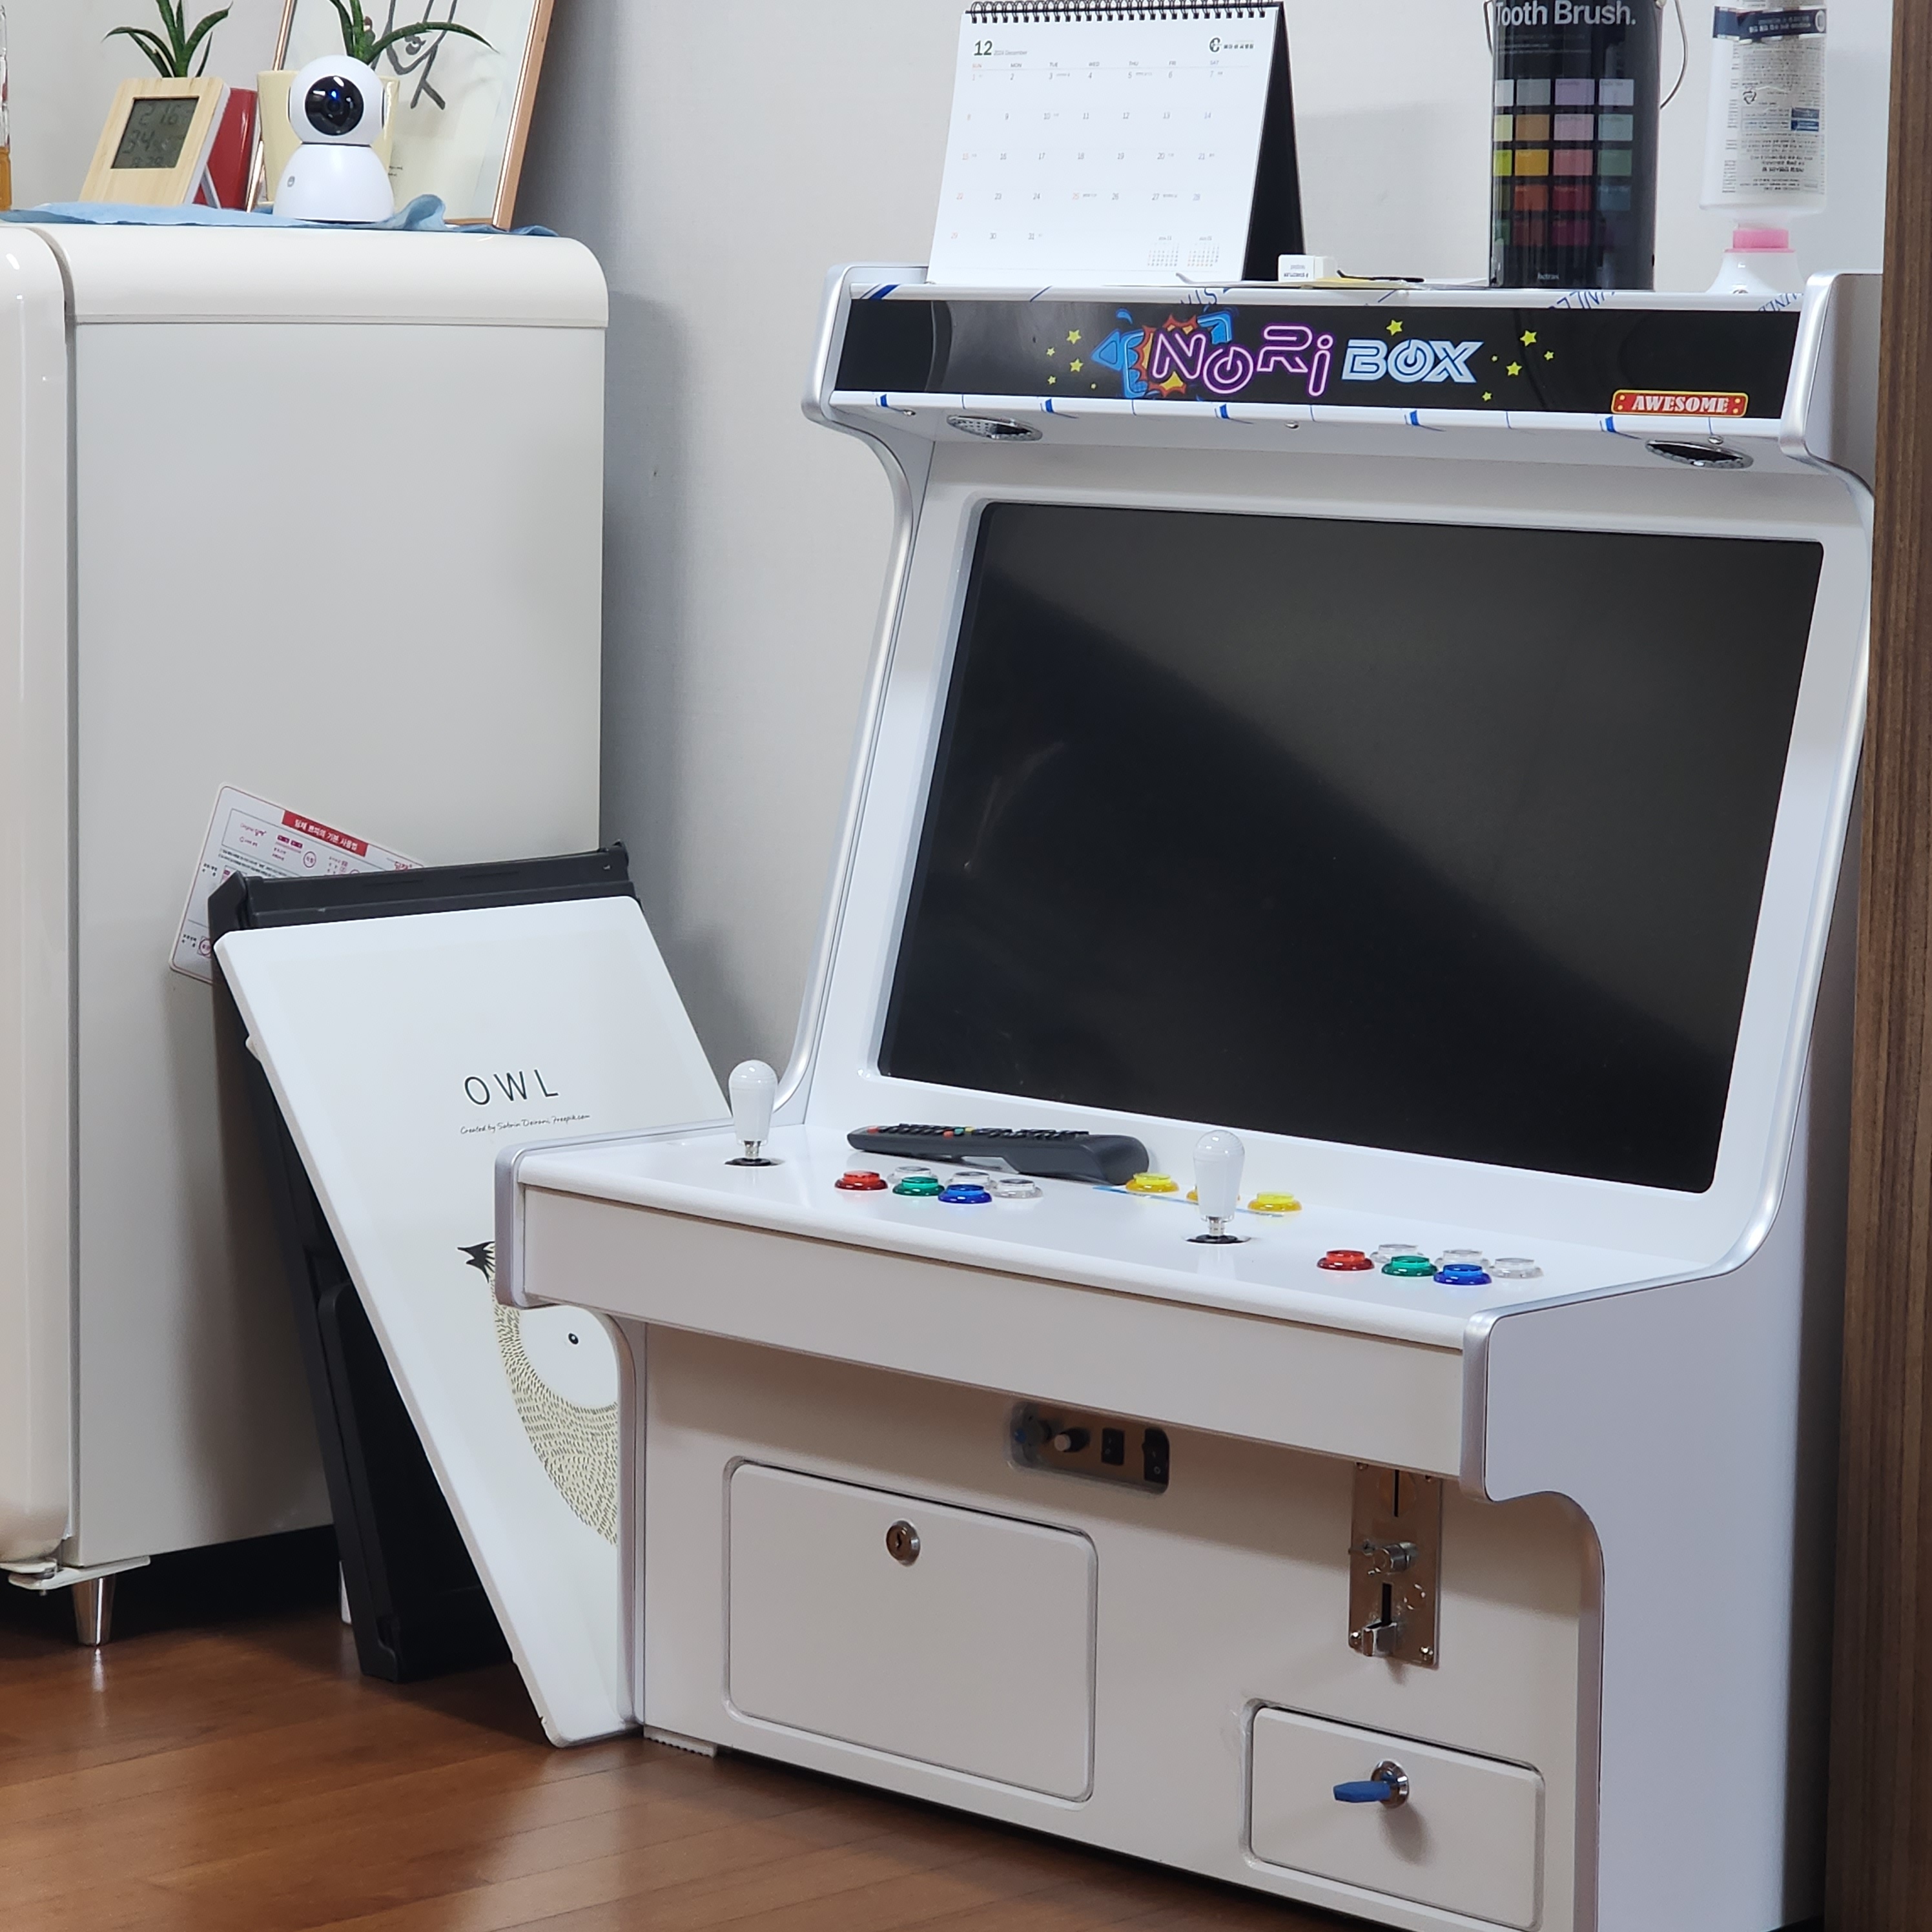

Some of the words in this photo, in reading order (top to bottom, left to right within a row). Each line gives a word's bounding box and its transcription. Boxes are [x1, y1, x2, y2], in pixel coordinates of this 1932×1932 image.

[1495, 0, 1548, 25] Tooth
[1554, 0, 1636, 25] Brush.
[973, 39, 993, 56] 12
[1000, 152, 1007, 161] 16
[1038, 152, 1046, 161] 17
[1116, 152, 1125, 160] 19
[1156, 152, 1166, 160] 20
[1197, 152, 1206, 161] 21
[994, 192, 1002, 201] 23
[1111, 192, 1119, 201] 26
[1151, 192, 1160, 201] 27
[1193, 193, 1201, 201] 28
[951, 231, 959, 240] 29
[1027, 232, 1035, 241] 31
[1341, 338, 1485, 384] BOX
[1631, 395, 1730, 413] AWESOME
[325, 832, 340, 843] 기본
[338, 838, 358, 851] 사용법
[464, 1069, 559, 1105] OWL
[460, 1125, 486, 1135] Created
[488, 1124, 496, 1133] by
